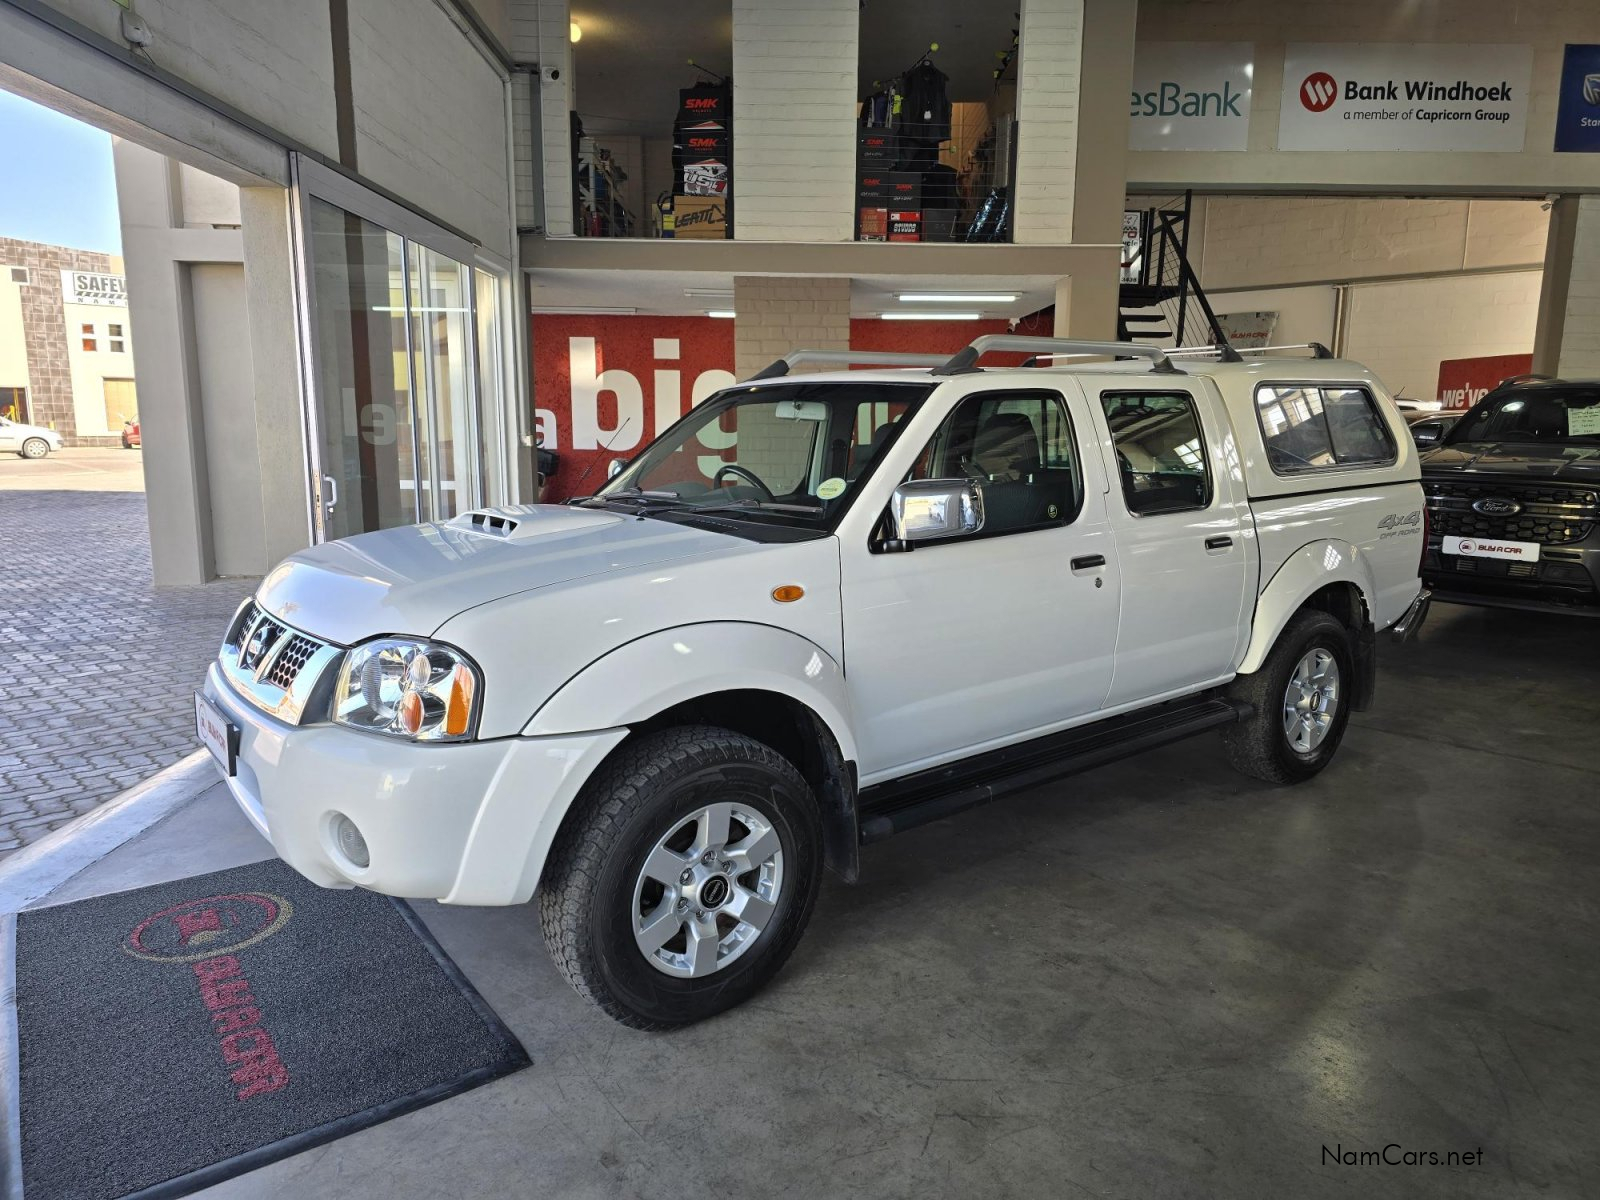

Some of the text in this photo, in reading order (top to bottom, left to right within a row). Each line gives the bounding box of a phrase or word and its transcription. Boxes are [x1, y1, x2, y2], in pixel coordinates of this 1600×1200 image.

[1344, 81, 1512, 101] Bank Windhoek
[684, 98, 719, 109] SMK
[1343, 108, 1510, 123] a member of Capricorn Group
[688, 138, 718, 148] SMK
[1484, 500, 1510, 512] Ford
[1377, 511, 1421, 530] 4x4
[1380, 527, 1421, 540] OFF ROAD
[1477, 544, 1496, 552] BUY
